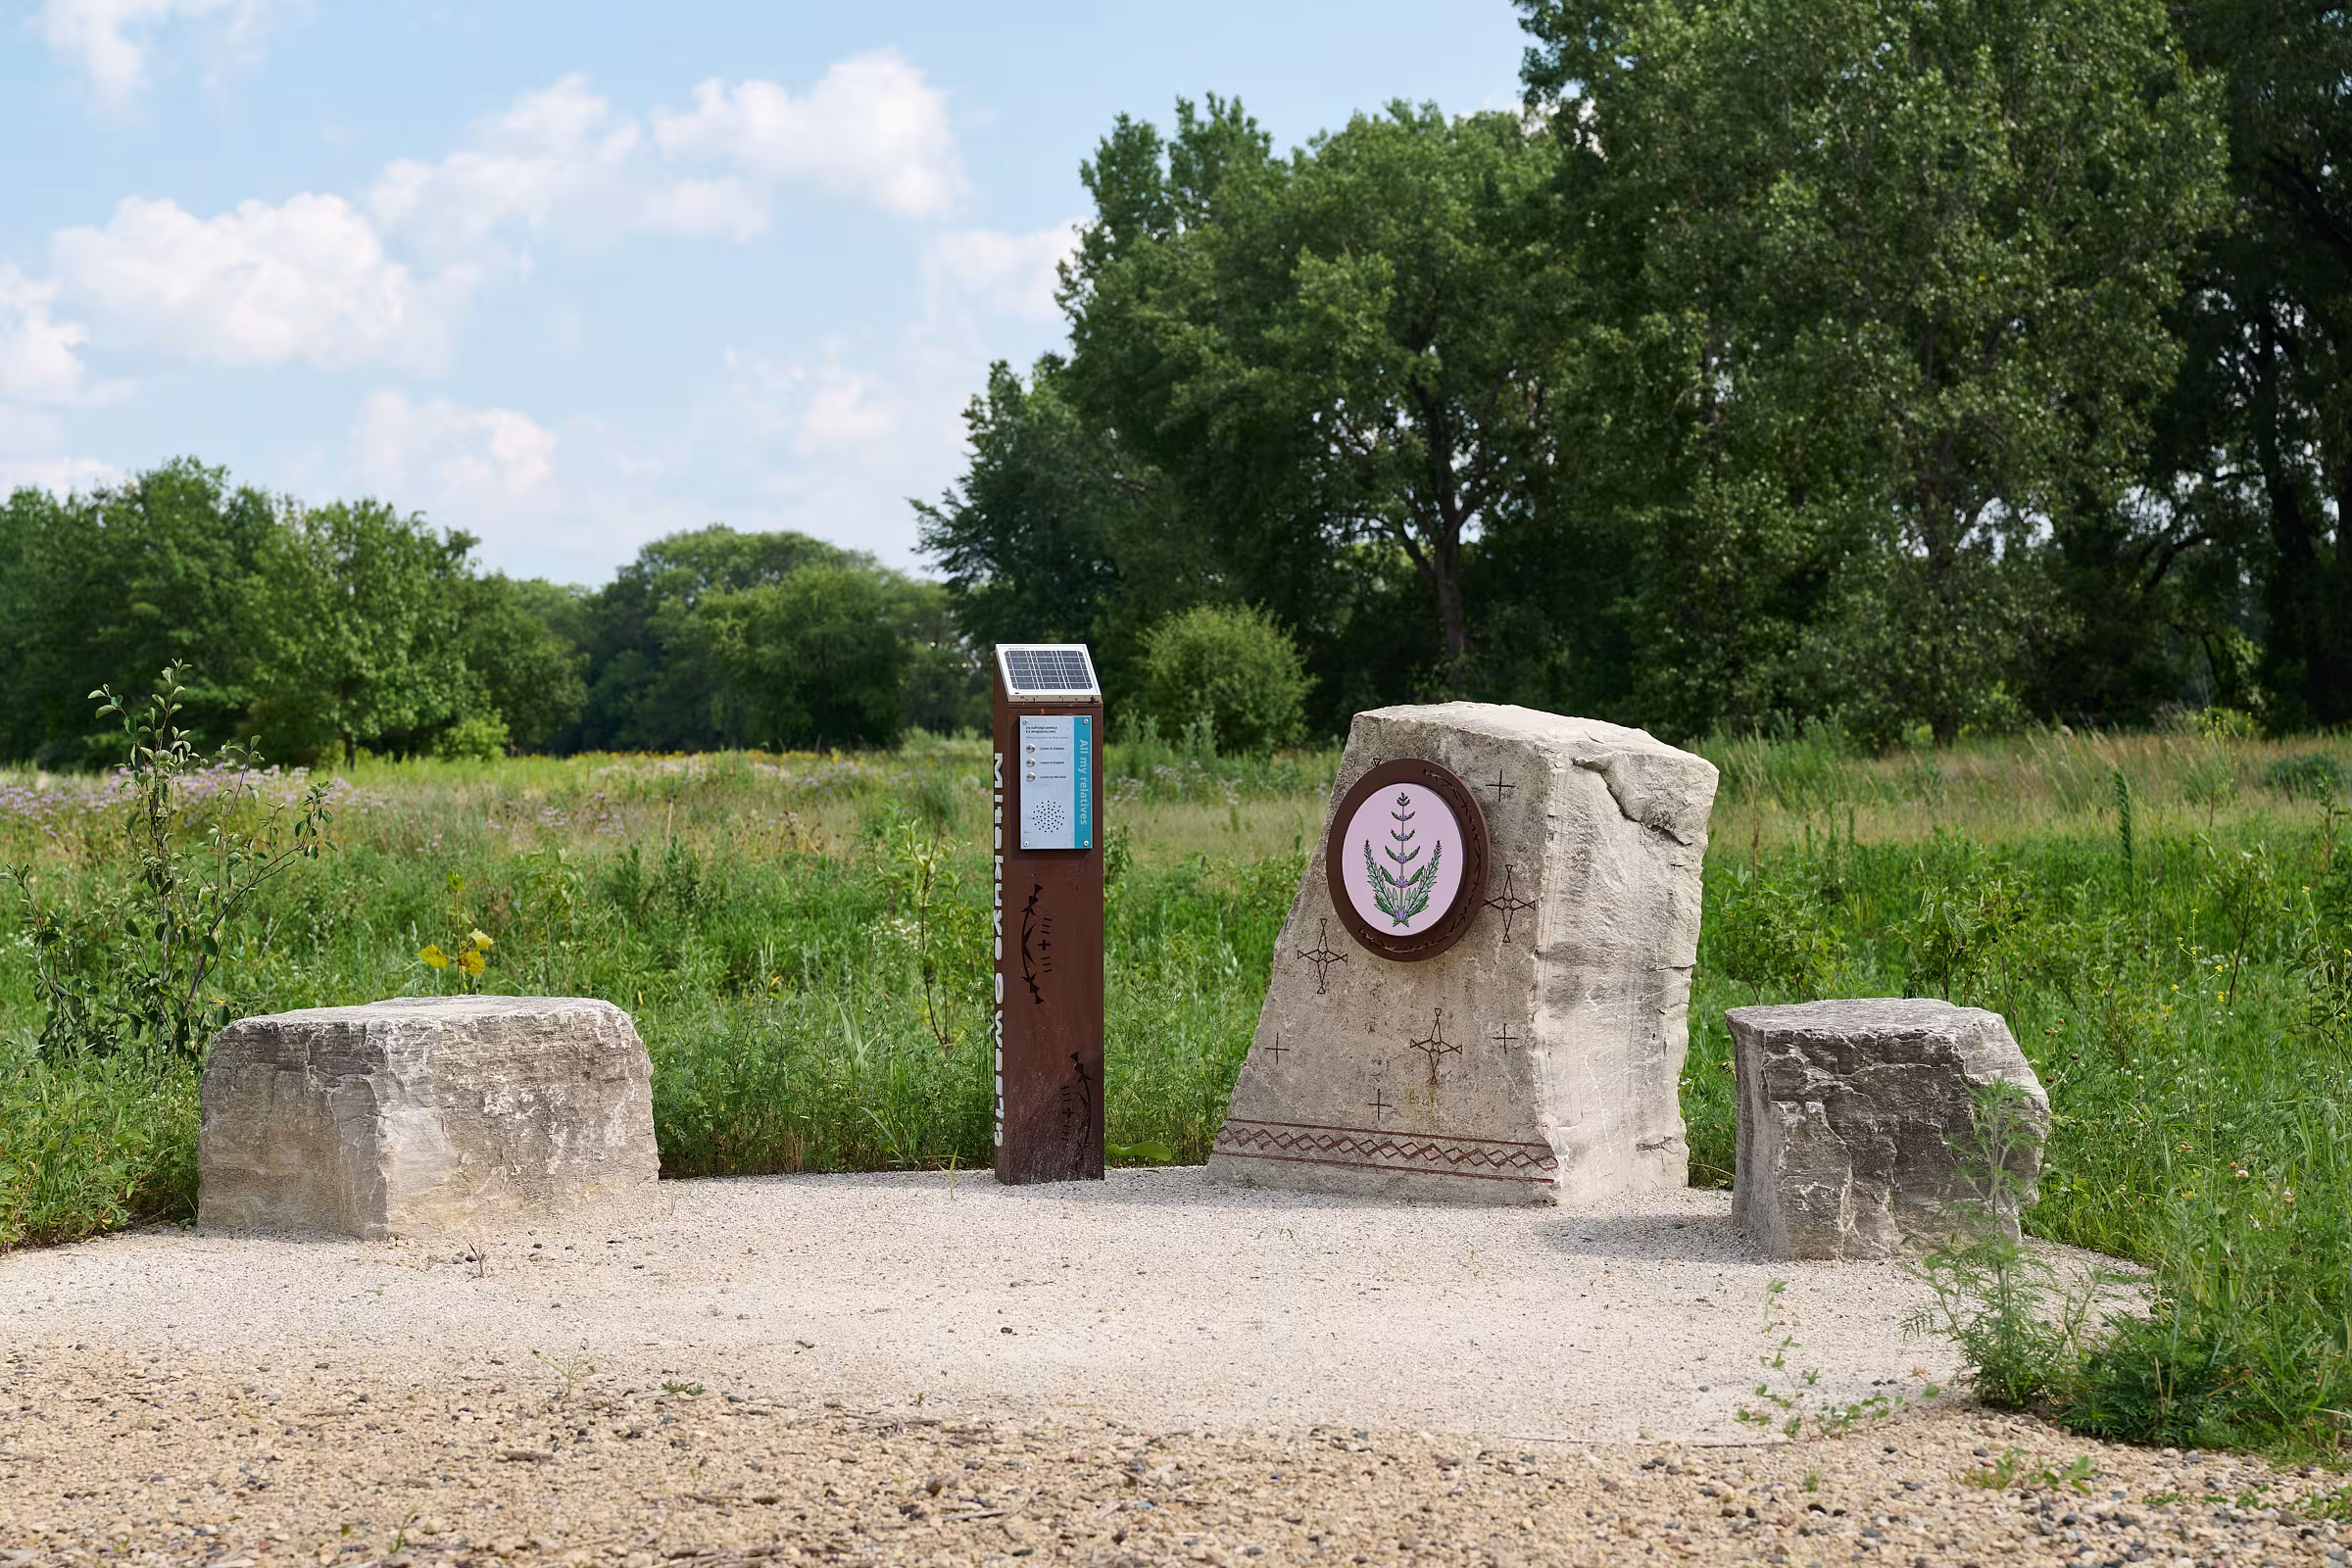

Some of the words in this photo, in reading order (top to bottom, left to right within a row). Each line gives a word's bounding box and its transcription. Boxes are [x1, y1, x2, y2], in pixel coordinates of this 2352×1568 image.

[1079, 739, 1089, 754] All
[1078, 757, 1087, 774] my
[1079, 777, 1089, 825] relatives
